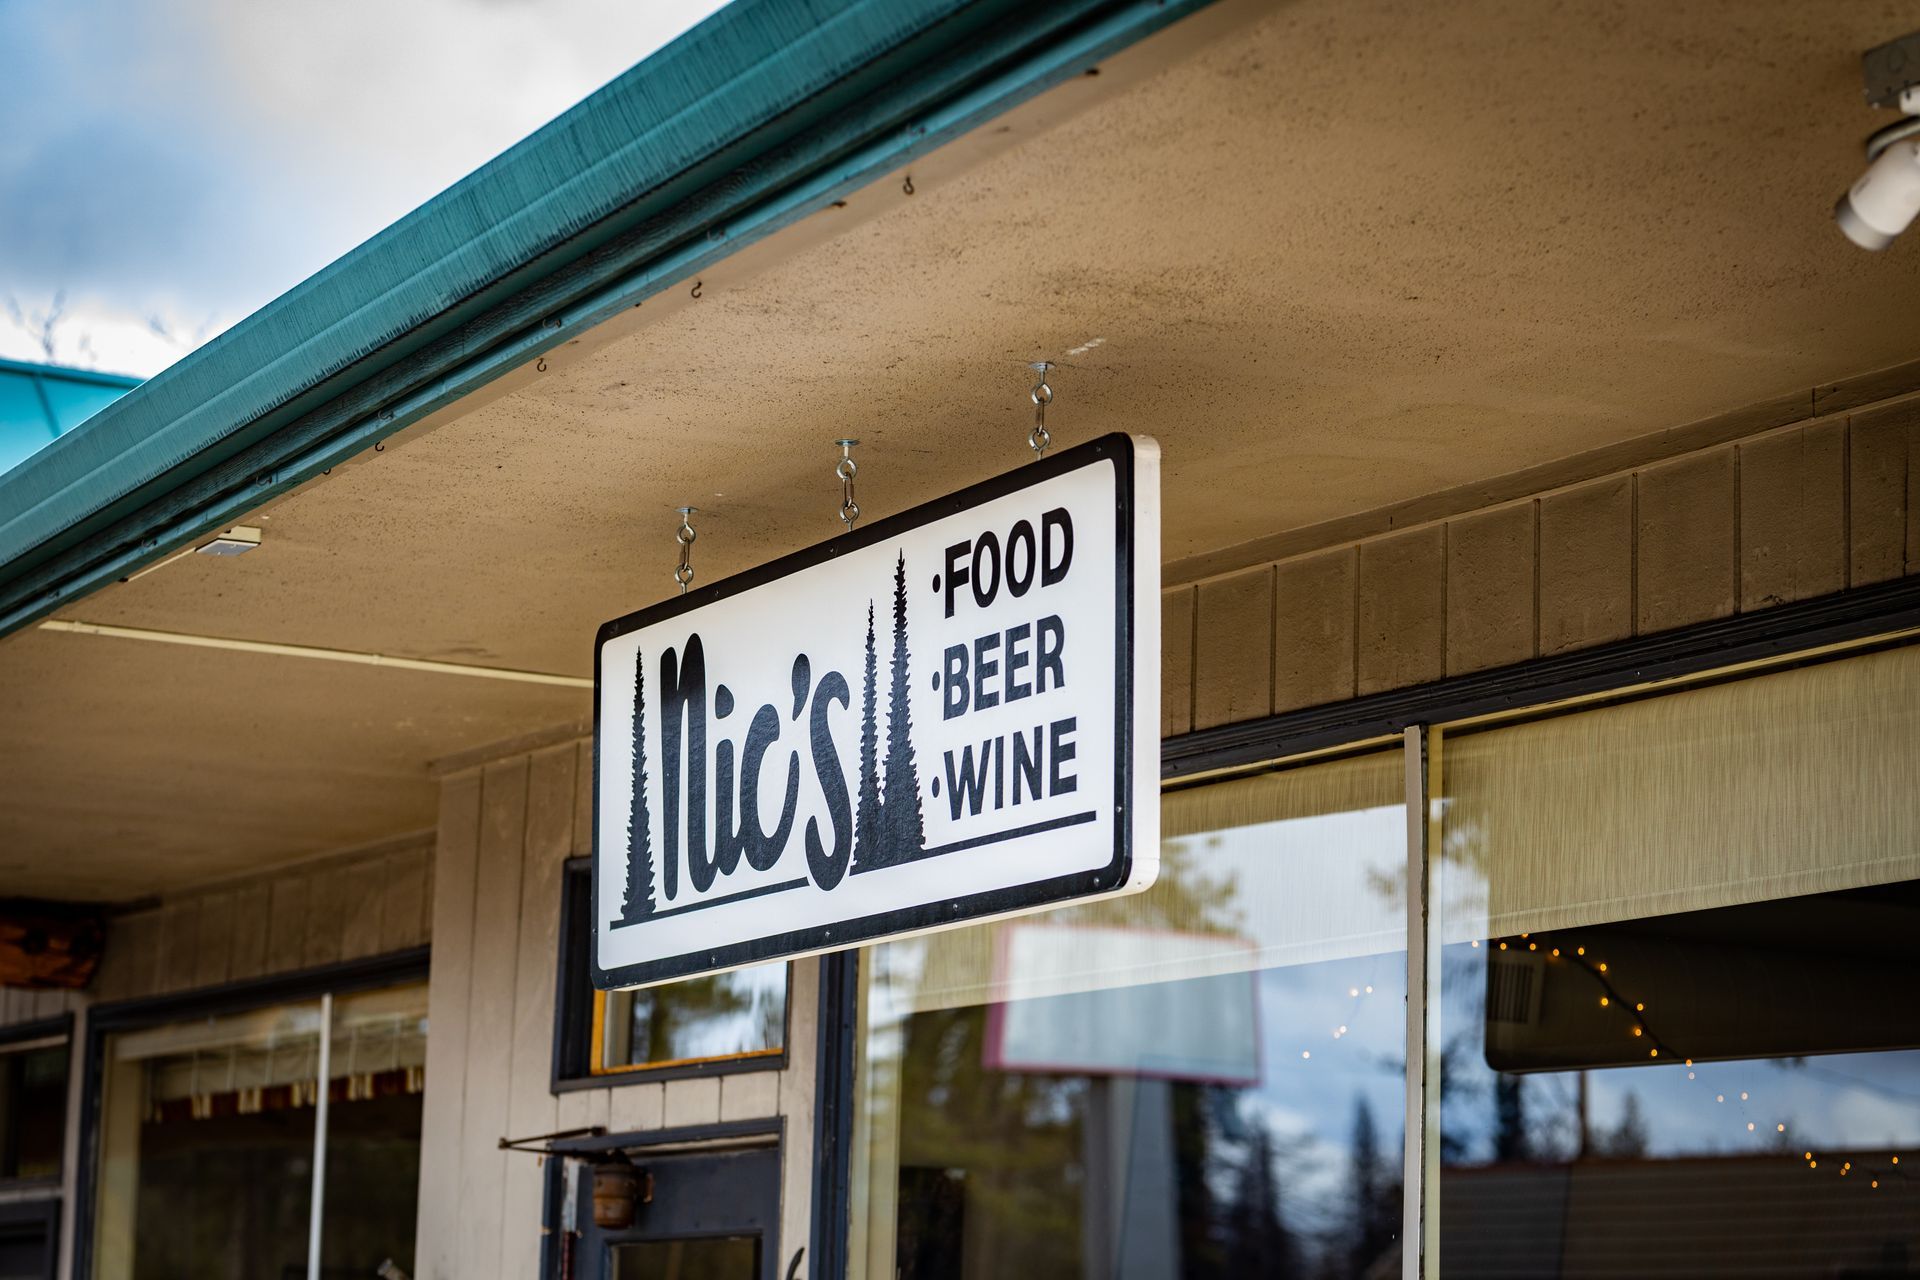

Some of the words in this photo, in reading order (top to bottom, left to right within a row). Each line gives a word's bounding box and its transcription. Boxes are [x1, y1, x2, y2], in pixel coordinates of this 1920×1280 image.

[945, 507, 1074, 619] FOOD
[943, 615, 1065, 721] BEER
[944, 717, 1078, 821] WINE
